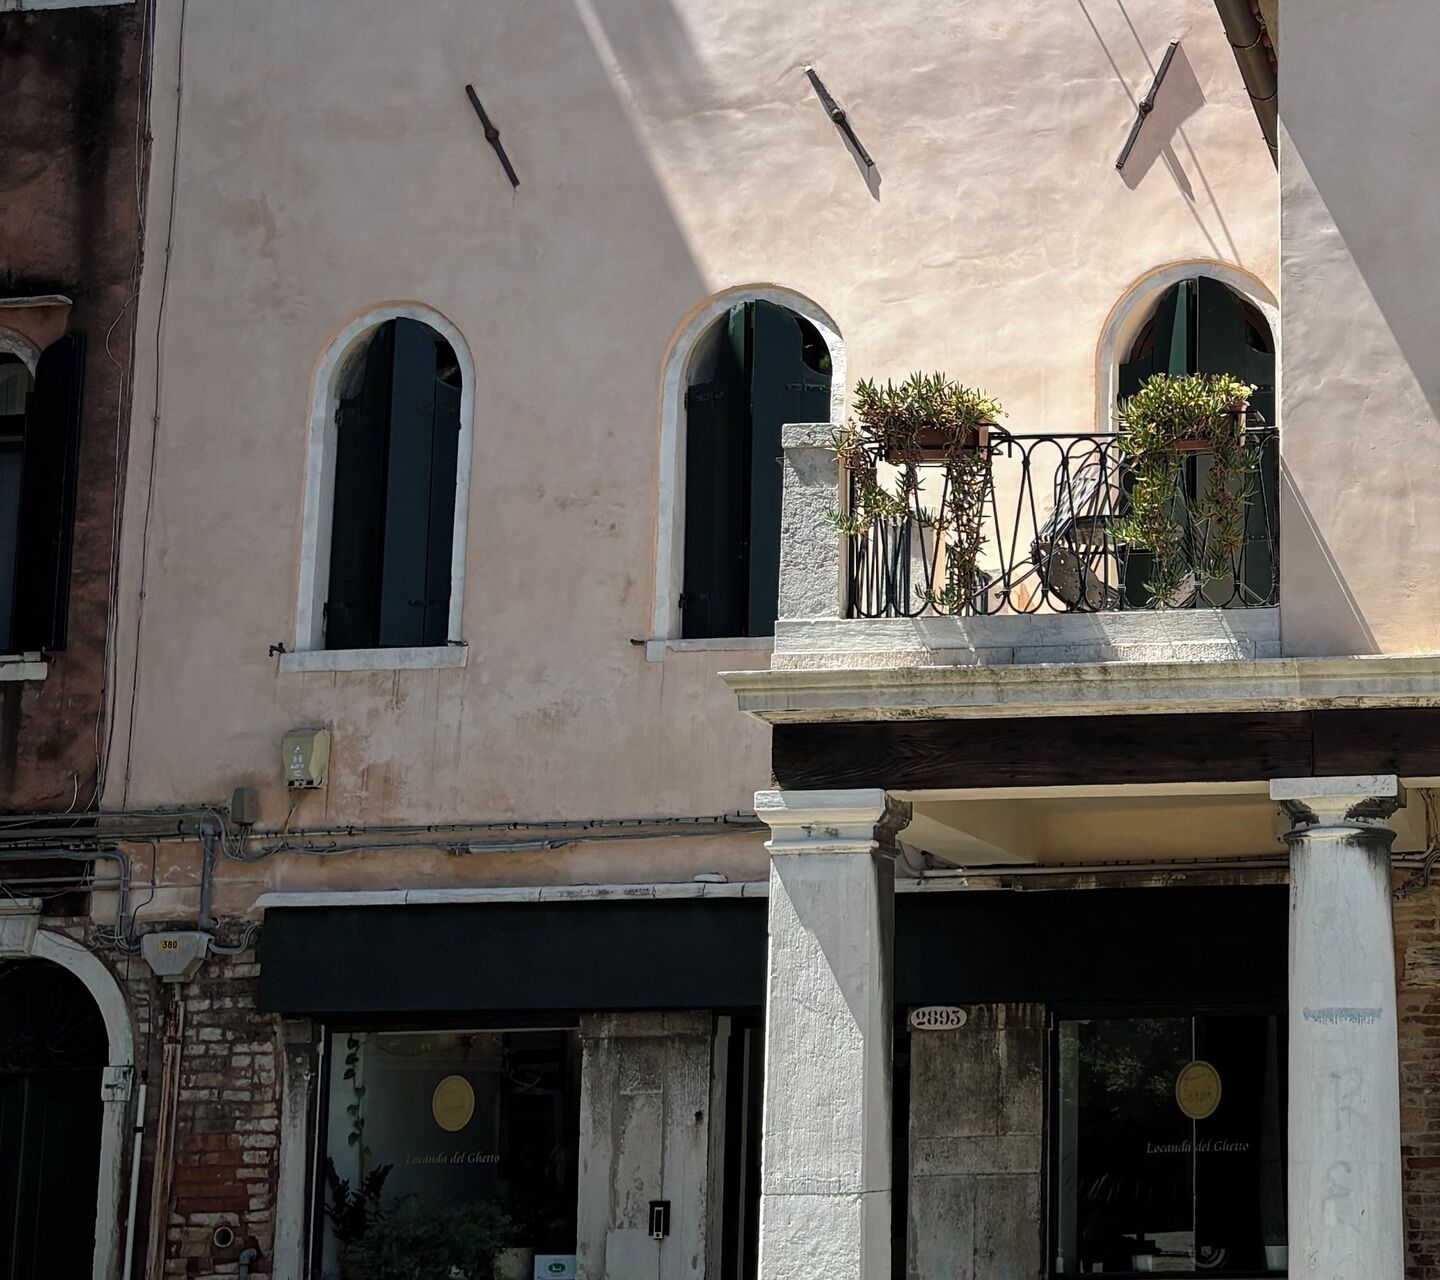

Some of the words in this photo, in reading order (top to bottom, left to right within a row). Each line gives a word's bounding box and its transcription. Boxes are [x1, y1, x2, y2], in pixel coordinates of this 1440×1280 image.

[915, 1009, 962, 1026] 2895
[1145, 1139, 1192, 1154] Locanda
[1193, 1138, 1212, 1152] del
[1213, 1138, 1250, 1152] Ghetto
[449, 1151, 467, 1164] del
[467, 1150, 501, 1164] Ghetto
